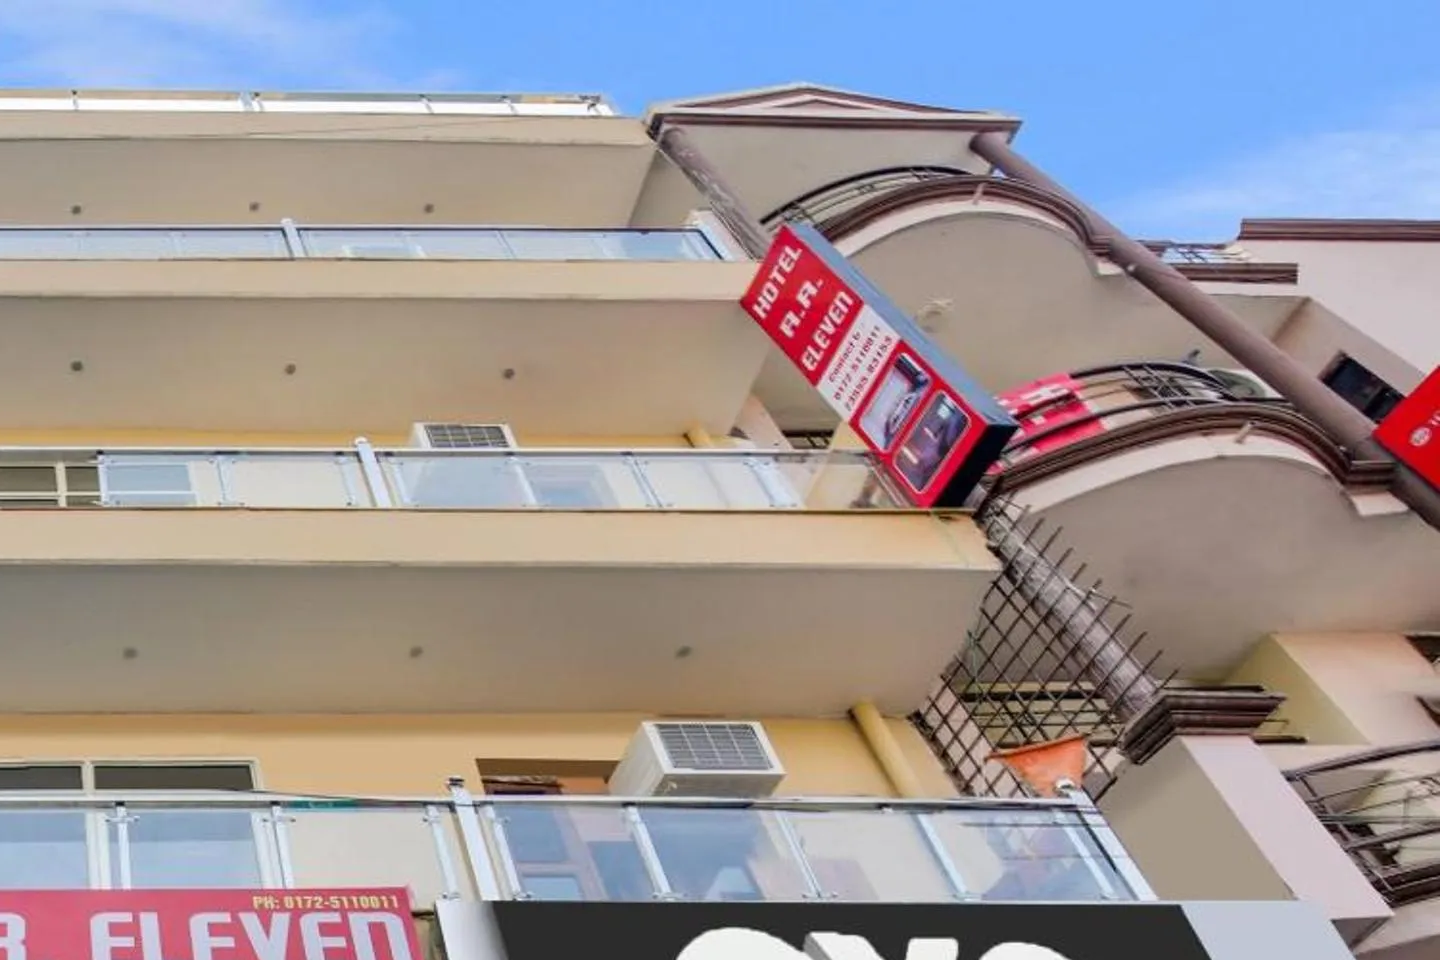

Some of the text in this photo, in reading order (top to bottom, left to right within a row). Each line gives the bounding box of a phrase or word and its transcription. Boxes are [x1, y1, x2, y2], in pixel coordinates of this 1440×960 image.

[752, 245, 803, 320] HOTEL
[800, 290, 855, 372] ELEVEN
[283, 895, 399, 910] 0172-5110011
